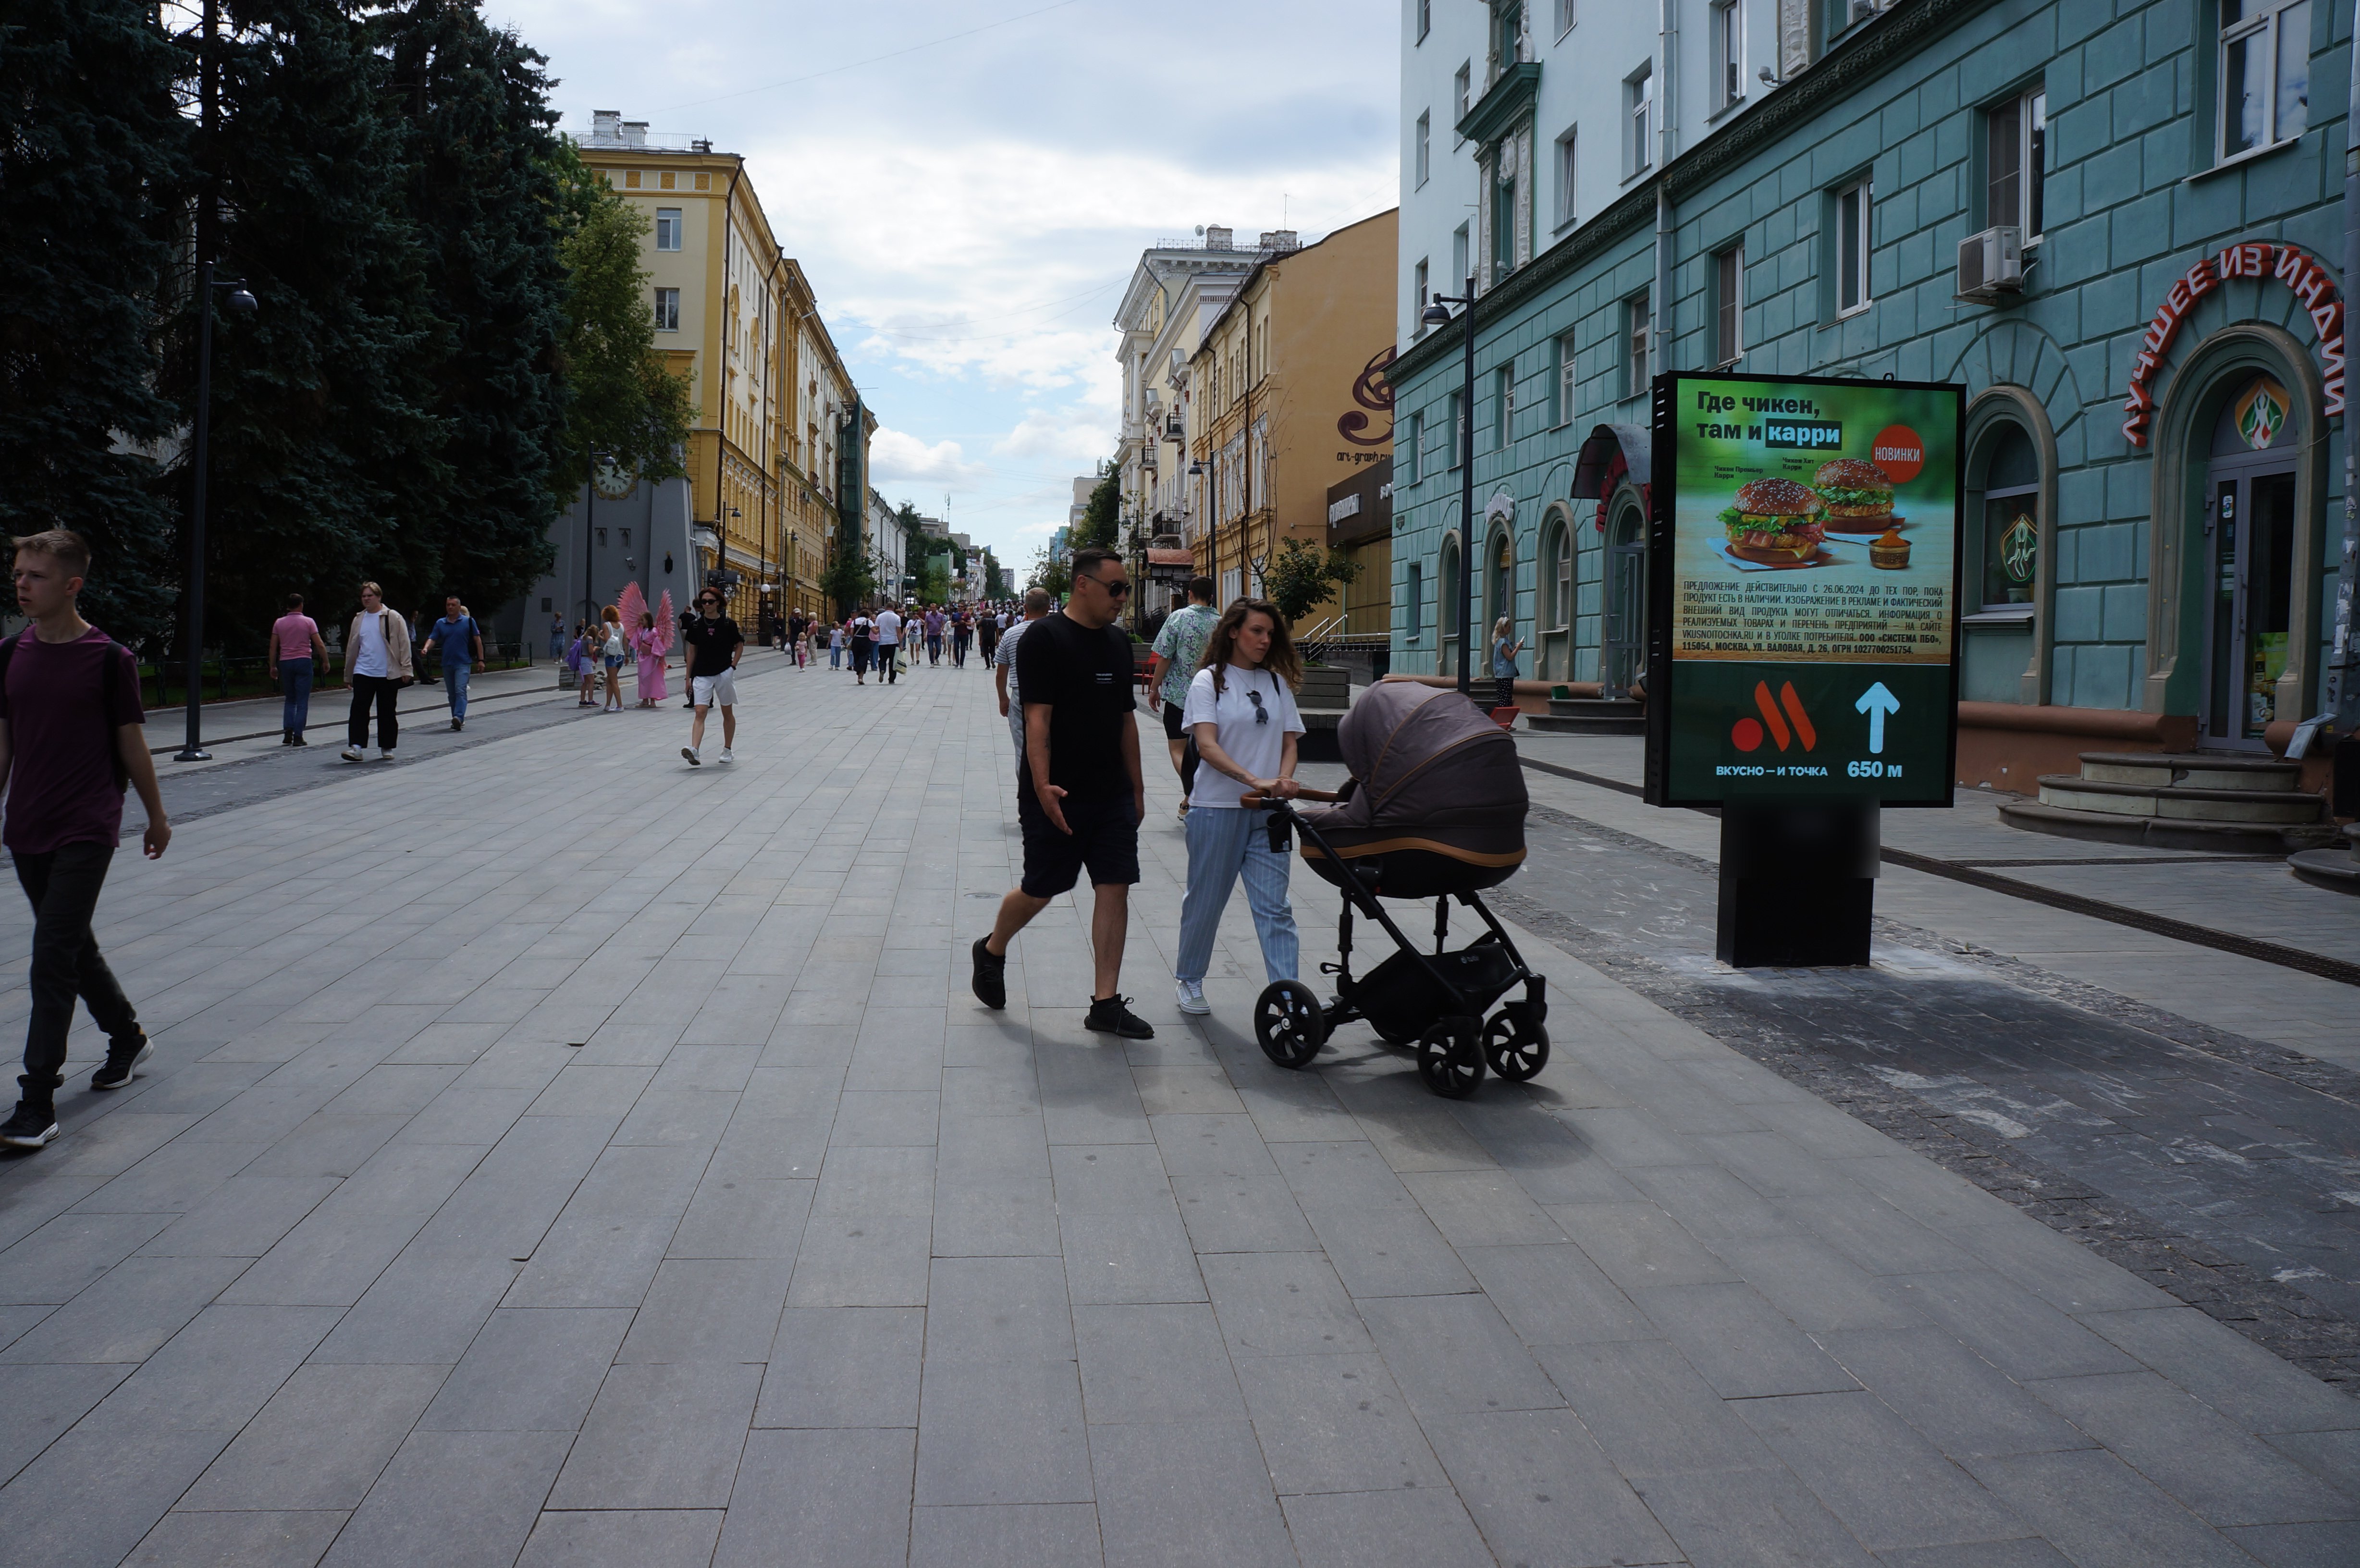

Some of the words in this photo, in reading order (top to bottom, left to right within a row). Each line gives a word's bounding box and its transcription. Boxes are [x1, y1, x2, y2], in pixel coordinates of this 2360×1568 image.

[2122, 259, 2220, 447] ЛУЧШЕЕ
[2219, 244, 2275, 280] ИЗ
[2274, 245, 2344, 417] ИНДИИ
[1697, 391, 1735, 414] Где
[1742, 397, 1819, 418] чикен,
[1696, 423, 1741, 440] там
[1748, 426, 1761, 440] и
[1768, 426, 1839, 447] карри
[1875, 447, 1919, 462] НОВИНКИ
[1684, 581, 1740, 592] ПРЕДЛОЖЕНИЕ
[1745, 581, 1807, 593] ДЕЙСТВИТЕЛЬНО
[1813, 585, 1818, 593] С
[1823, 585, 1864, 594] 26.06.2024
[1869, 586, 1880, 596] ДО
[1885, 586, 1897, 595] ТЕХ
[1903, 587, 1918, 596] ПОР,
[1924, 587, 1943, 596] ПОКА
[1684, 593, 1717, 603] ПРОДУКТ
[1719, 594, 1735, 602] ЕСТЬ
[1738, 594, 1743, 603] В
[1745, 594, 1783, 604] НАЛИЧИИ.
[1785, 596, 1840, 605] ИЗОБРАЖЕНИЕ
[1842, 597, 1846, 605] В
[1848, 597, 1881, 606] РЕКЛАМЕ
[1883, 598, 1888, 606] И
[1891, 597, 1942, 608] ФАКТИЧЕСКИЙ
[1684, 604, 1721, 615] ВНЕШНИЙ
[1729, 606, 1745, 617] ВИД
[1752, 607, 1788, 617] ПРОДУКТА
[1795, 608, 1819, 617] МОГУТ
[1825, 609, 1872, 618] ОТЛИЧАТЬСЯ.
[1879, 610, 1930, 621] ИНФОРМАЦИЯ
[1937, 611, 1942, 620] О
[1683, 617, 1737, 627] РЕАЛИЗУЕМЫХ
[1744, 619, 1774, 627] ТОВАРАХ
[1792, 620, 1829, 629] ПЕРЕЧЕНЬ
[1835, 620, 1887, 631] ПРЕДПРИЯТИЙ
[1905, 622, 1915, 630] НА
[1920, 621, 1942, 631] САЙТЕ
[1683, 630, 1753, 640] VKUSNOITOCHKA.RU
[1757, 631, 1762, 639] И
[1766, 632, 1770, 640] В
[1774, 632, 1801, 641] УГОЛКЕ
[1804, 632, 1856, 641] ПОТРЕБИТЕЛЯ.
[1859, 634, 1874, 642] ООО
[1879, 634, 1917, 643] «СИСТЕМА
[1920, 635, 1941, 645] ПБО»,
[1682, 642, 1713, 652] 115054,
[1715, 642, 1750, 653] МОСКВА,
[1753, 643, 1764, 651] УЛ.
[1767, 643, 1805, 653] ВАЛОВАЯ,
[1807, 645, 1816, 653] Д.
[1818, 645, 1829, 654] 26,
[1832, 645, 1852, 653] ОГРН
[1854, 645, 1914, 654] 1027700251754.
[1716, 766, 1764, 776] ВКУСНО
[1777, 767, 1785, 776] И
[1788, 767, 1828, 776] ТОЧКА
[1847, 761, 1883, 777] 650
